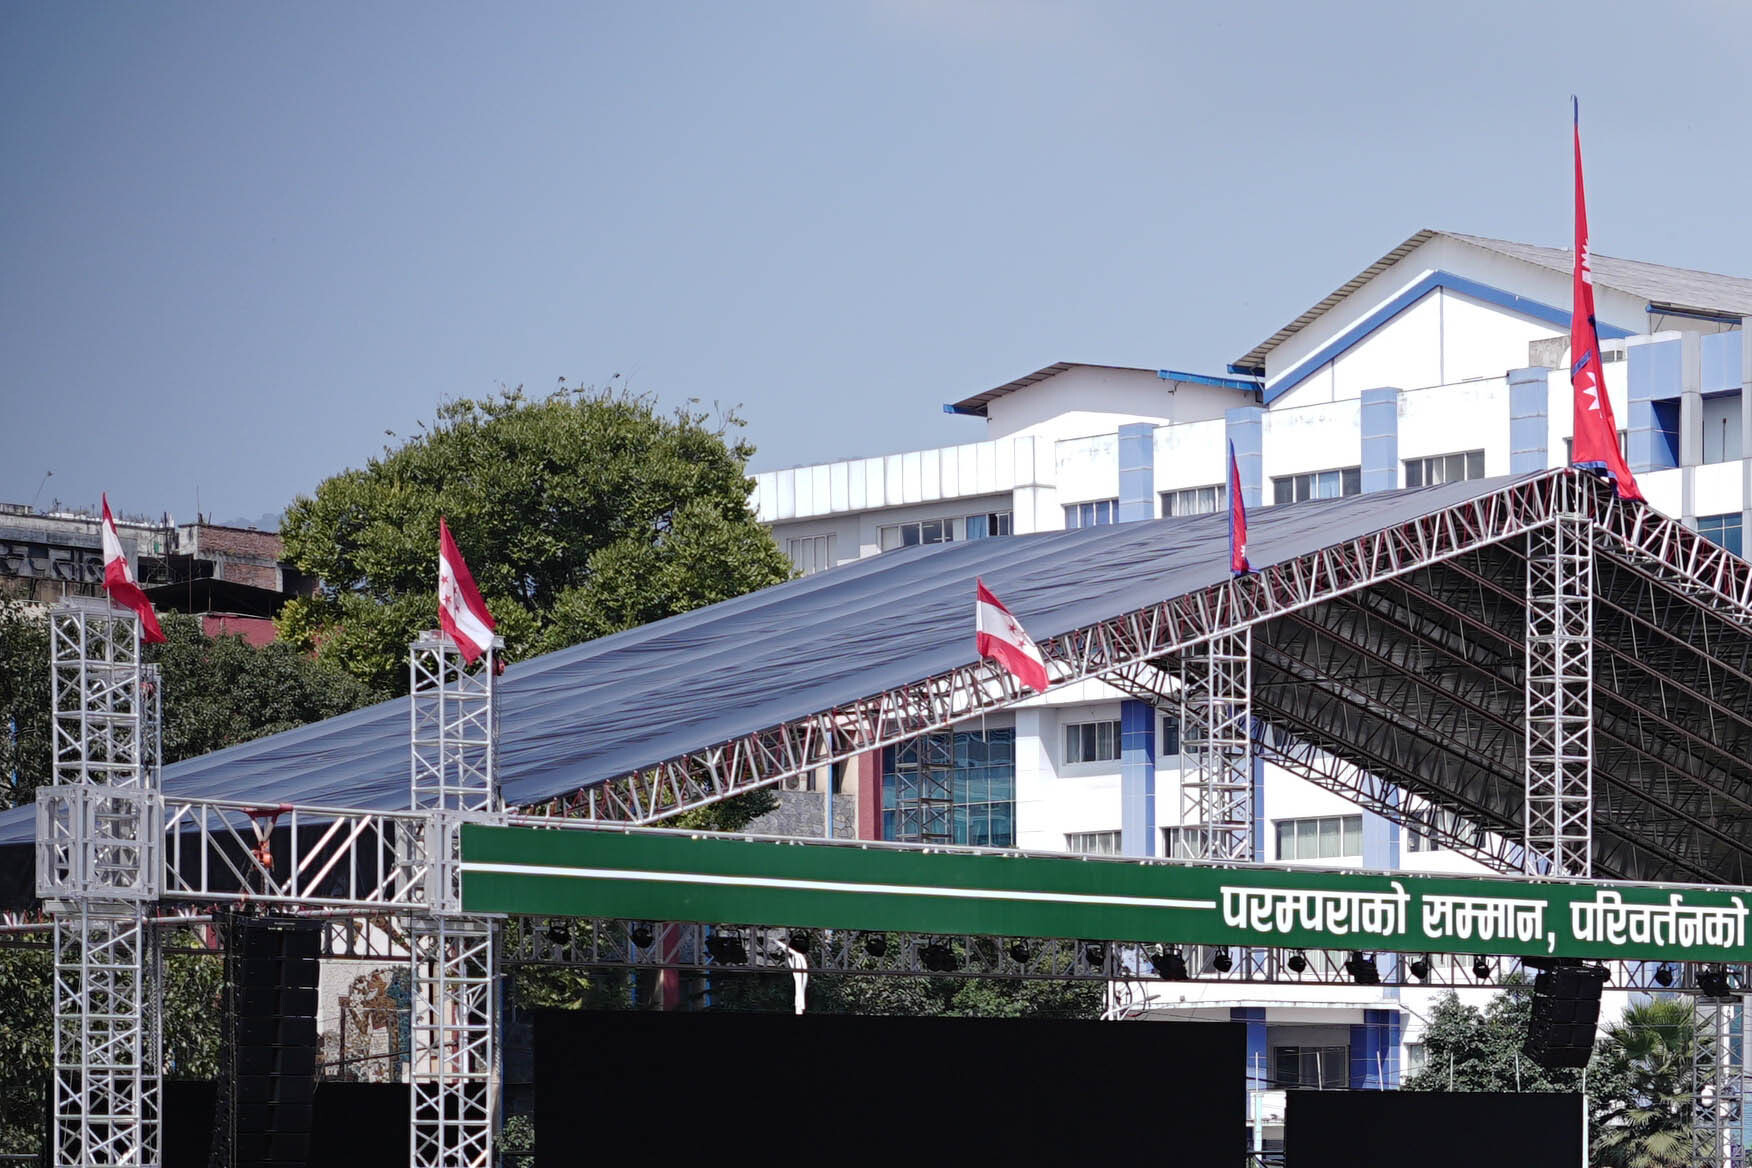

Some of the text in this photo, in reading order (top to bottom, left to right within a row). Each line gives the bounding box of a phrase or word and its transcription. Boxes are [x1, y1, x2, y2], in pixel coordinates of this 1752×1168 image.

[1220, 881, 1411, 936] परम्पराको
[1422, 895, 1556, 954] सम्मान,
[1569, 890, 1749, 948] परिवर्तनको
